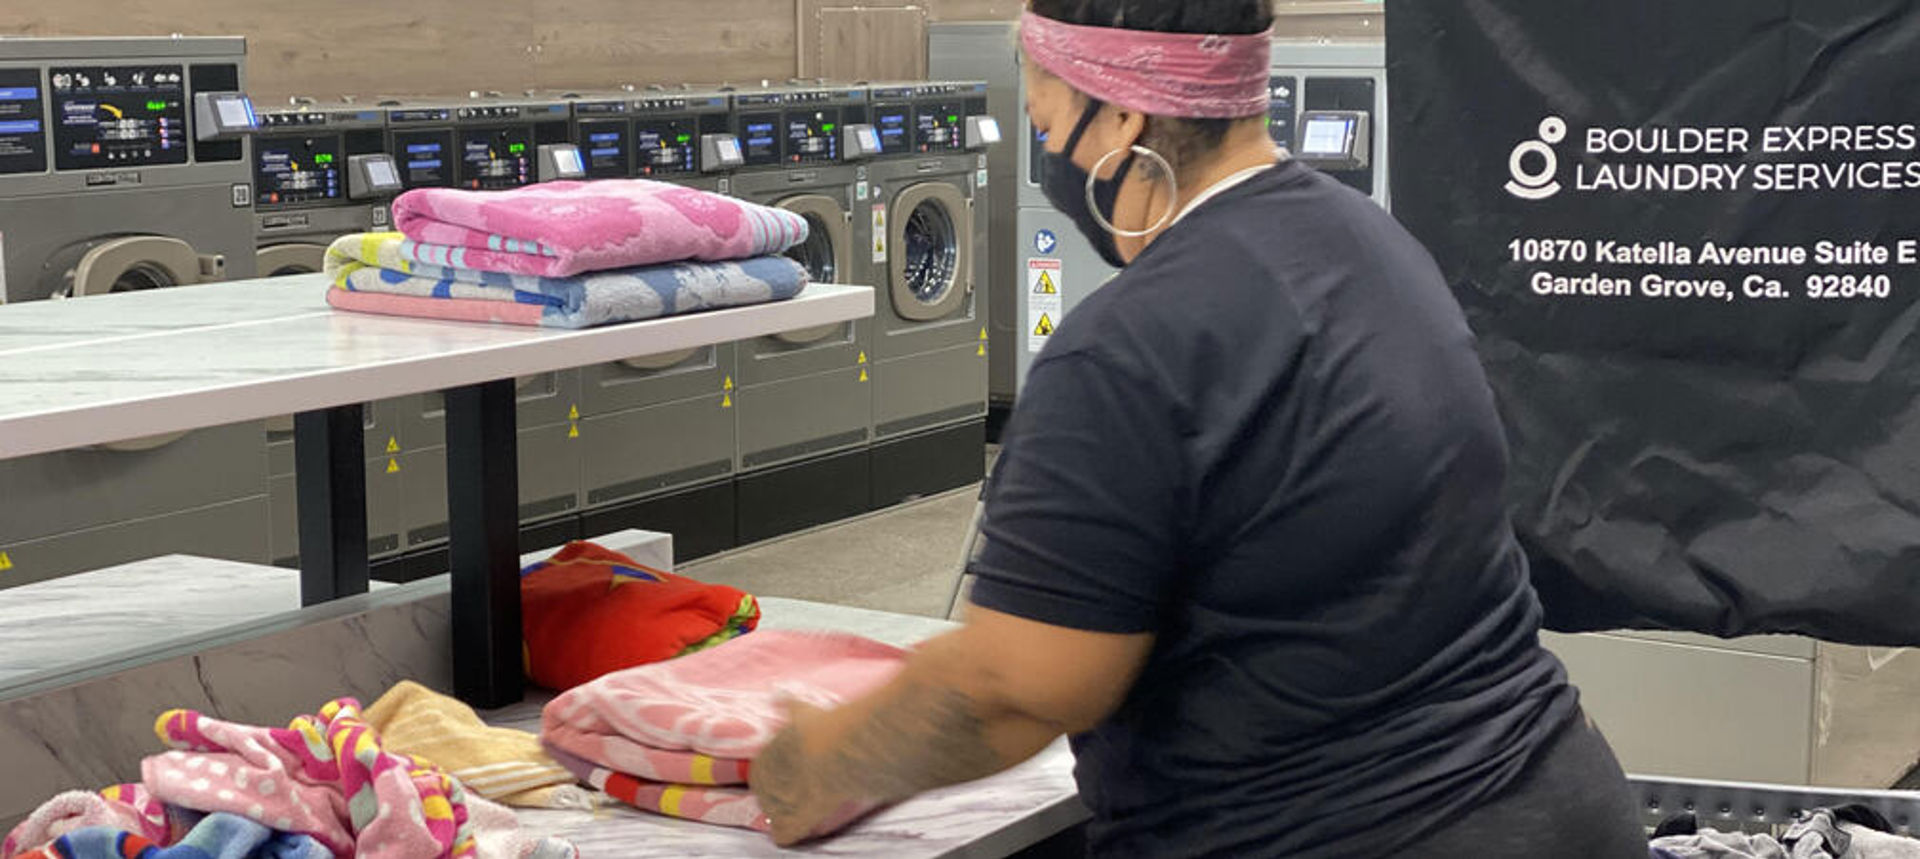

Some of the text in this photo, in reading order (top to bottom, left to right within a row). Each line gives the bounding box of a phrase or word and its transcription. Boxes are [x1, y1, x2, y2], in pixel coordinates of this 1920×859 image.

[1586, 124, 1916, 154] BOULDER EXPRESS
[1576, 161, 1920, 191] LAUNDRY SERVICES
[1508, 238, 1917, 265] 10870 Katella Avenue Suite E
[1530, 271, 1891, 302] Garden Grove, Ca. 92840
